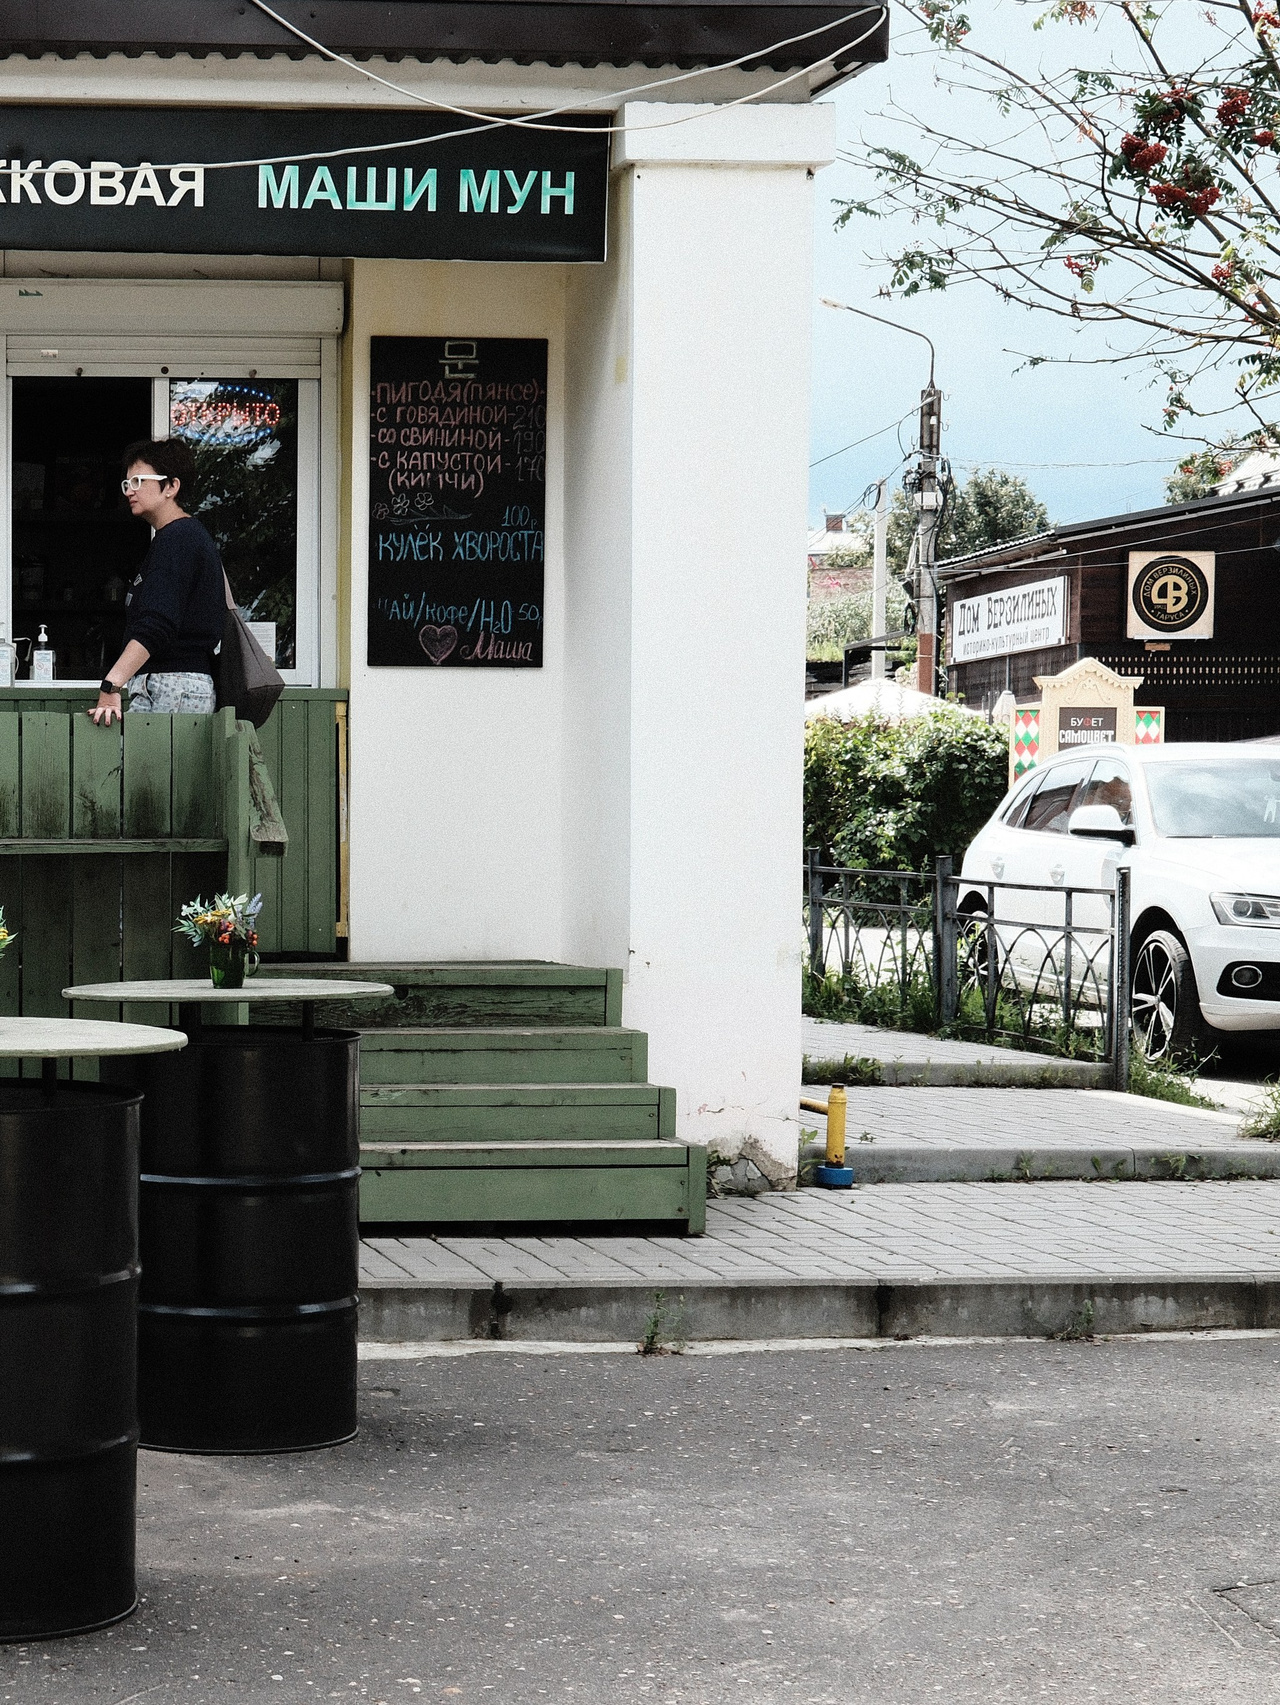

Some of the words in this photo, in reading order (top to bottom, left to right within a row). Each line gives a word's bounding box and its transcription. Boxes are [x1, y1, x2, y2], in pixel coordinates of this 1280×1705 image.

[258, 164, 437, 213] МАШИ
[458, 169, 576, 215] МУН
[171, 402, 280, 425] ОТКРЫТО
[451, 530, 544, 562] ХВОРОСТА
[1070, 717, 1104, 727] БУФЕТ
[1059, 730, 1114, 744] САМОЦВЕТ
